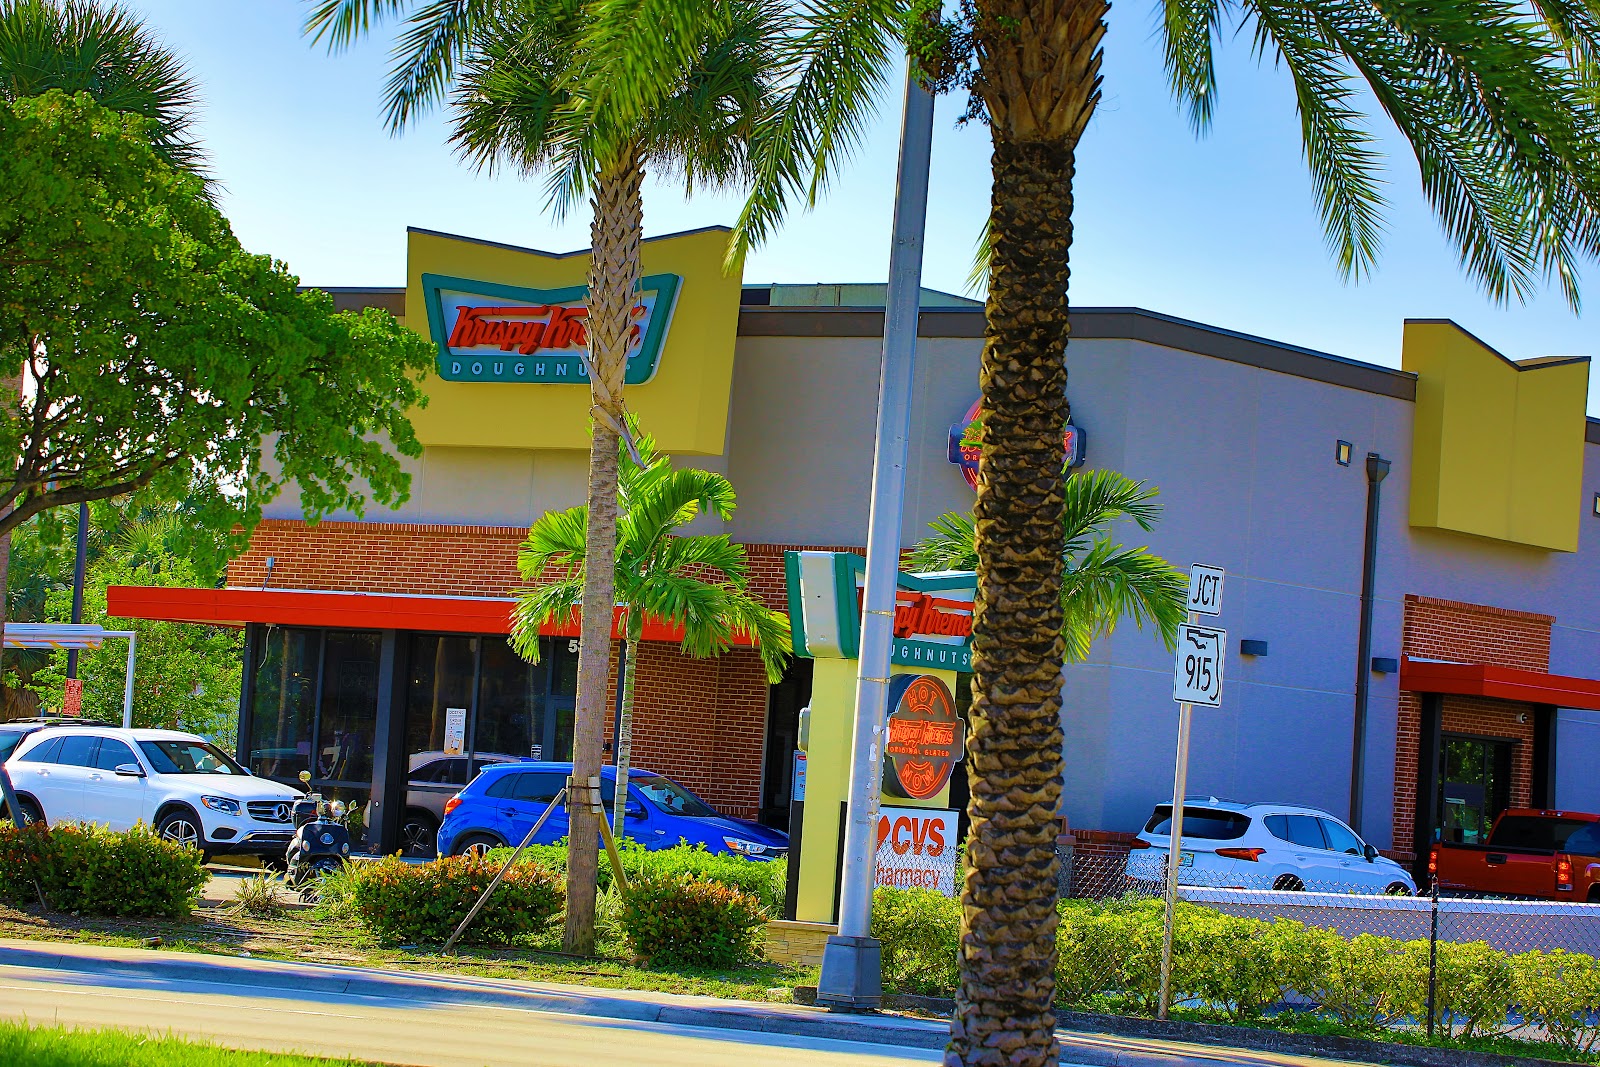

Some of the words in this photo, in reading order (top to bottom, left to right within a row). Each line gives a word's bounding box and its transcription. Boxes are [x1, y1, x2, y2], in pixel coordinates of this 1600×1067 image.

[448, 304, 549, 355] Krispy
[1192, 573, 1220, 606] JCT
[917, 594, 976, 637] Kreme
[1185, 654, 1212, 692] 915
[907, 686, 937, 708] HOT
[890, 746, 922, 756] ORIGINAL
[924, 749, 950, 757] GLAZED
[902, 763, 935, 789] NOW
[891, 816, 946, 857] CVS
[875, 861, 941, 889] harmacy
